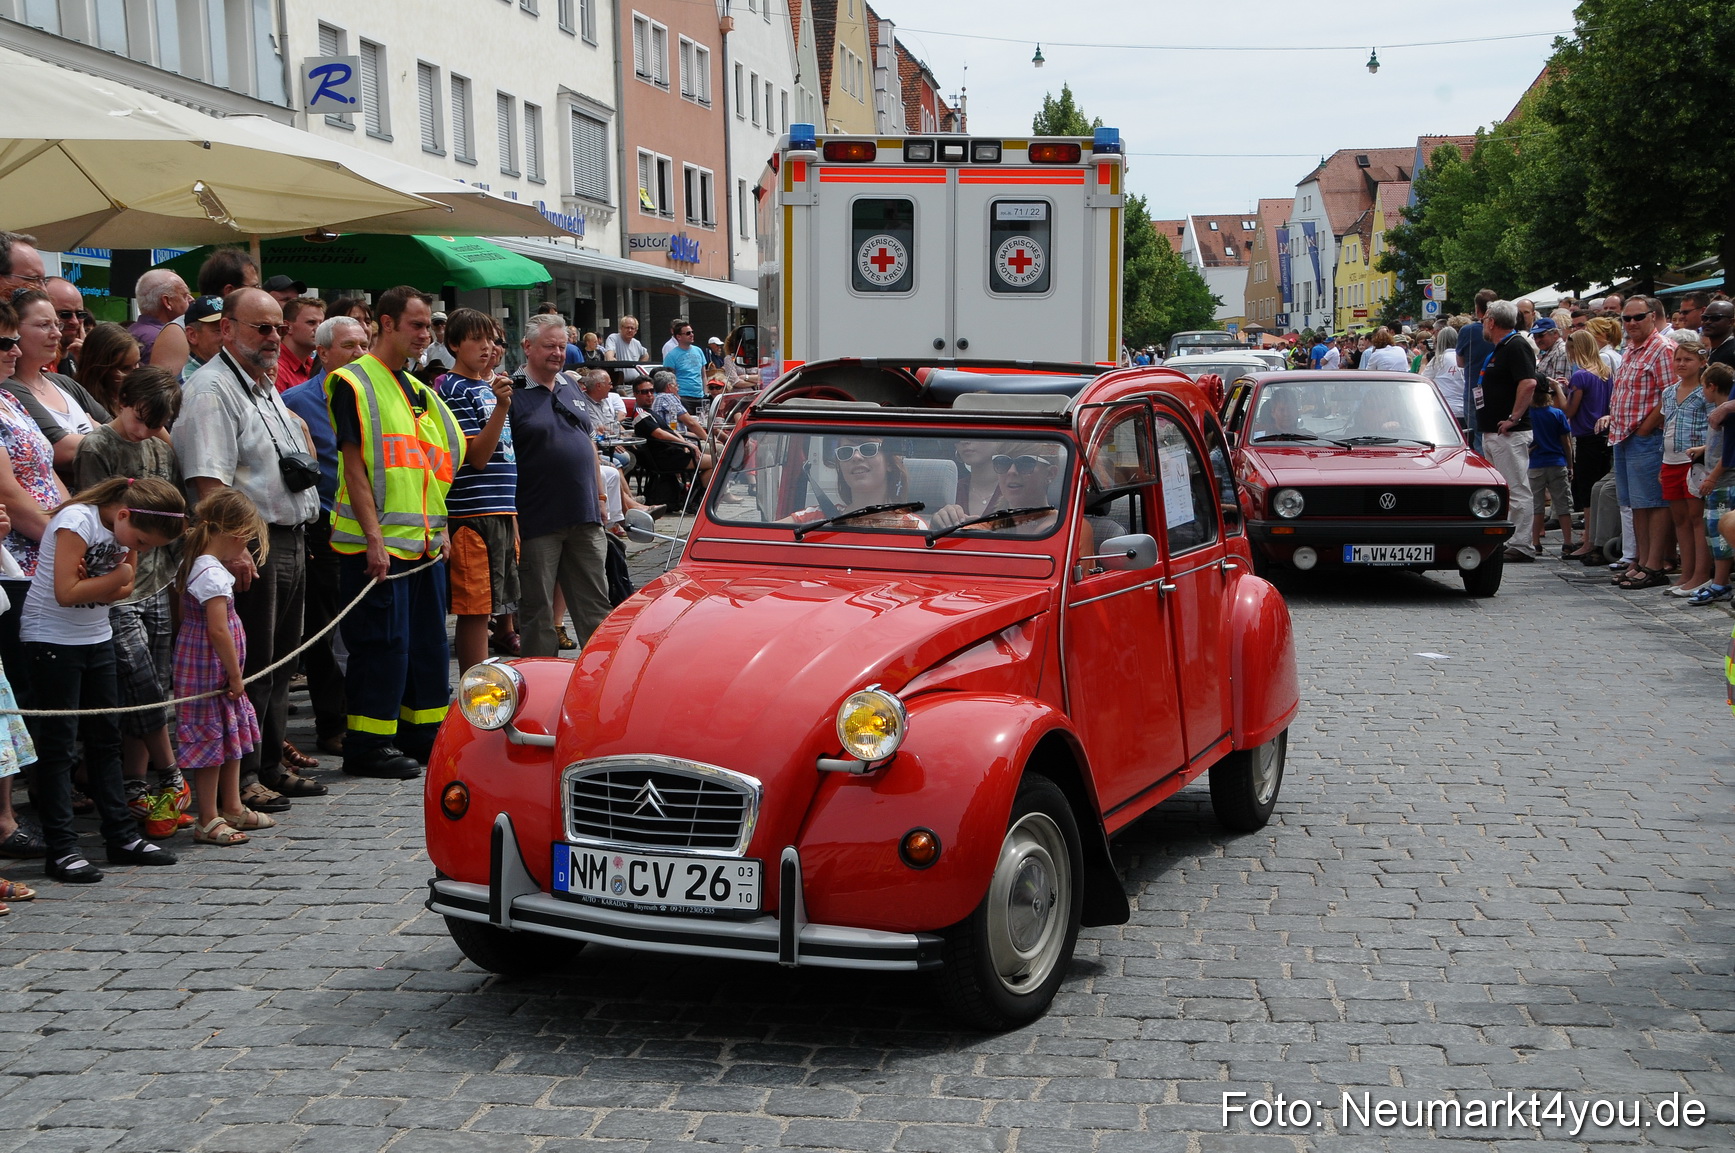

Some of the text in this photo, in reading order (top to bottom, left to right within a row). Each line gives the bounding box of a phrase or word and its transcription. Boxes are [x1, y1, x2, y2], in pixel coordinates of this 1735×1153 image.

[1030, 208, 1040, 216] 22
[862, 238, 904, 258] BAYERISCHES
[1000, 240, 1041, 260] BAYERISCHES
[260, 253, 367, 264] ammsbräu
[862, 261, 904, 282] ROTES KREUZ
[1000, 262, 1041, 283] ROTES KREUZ
[1353, 547, 1362, 561] M
[1371, 547, 1387, 561] VW
[559, 872, 565, 882] D
[570, 851, 731, 902] NM CV 26
[738, 867, 753, 877] 03
[582, 896, 597, 904] AUTO
[738, 893, 752, 903] 10
